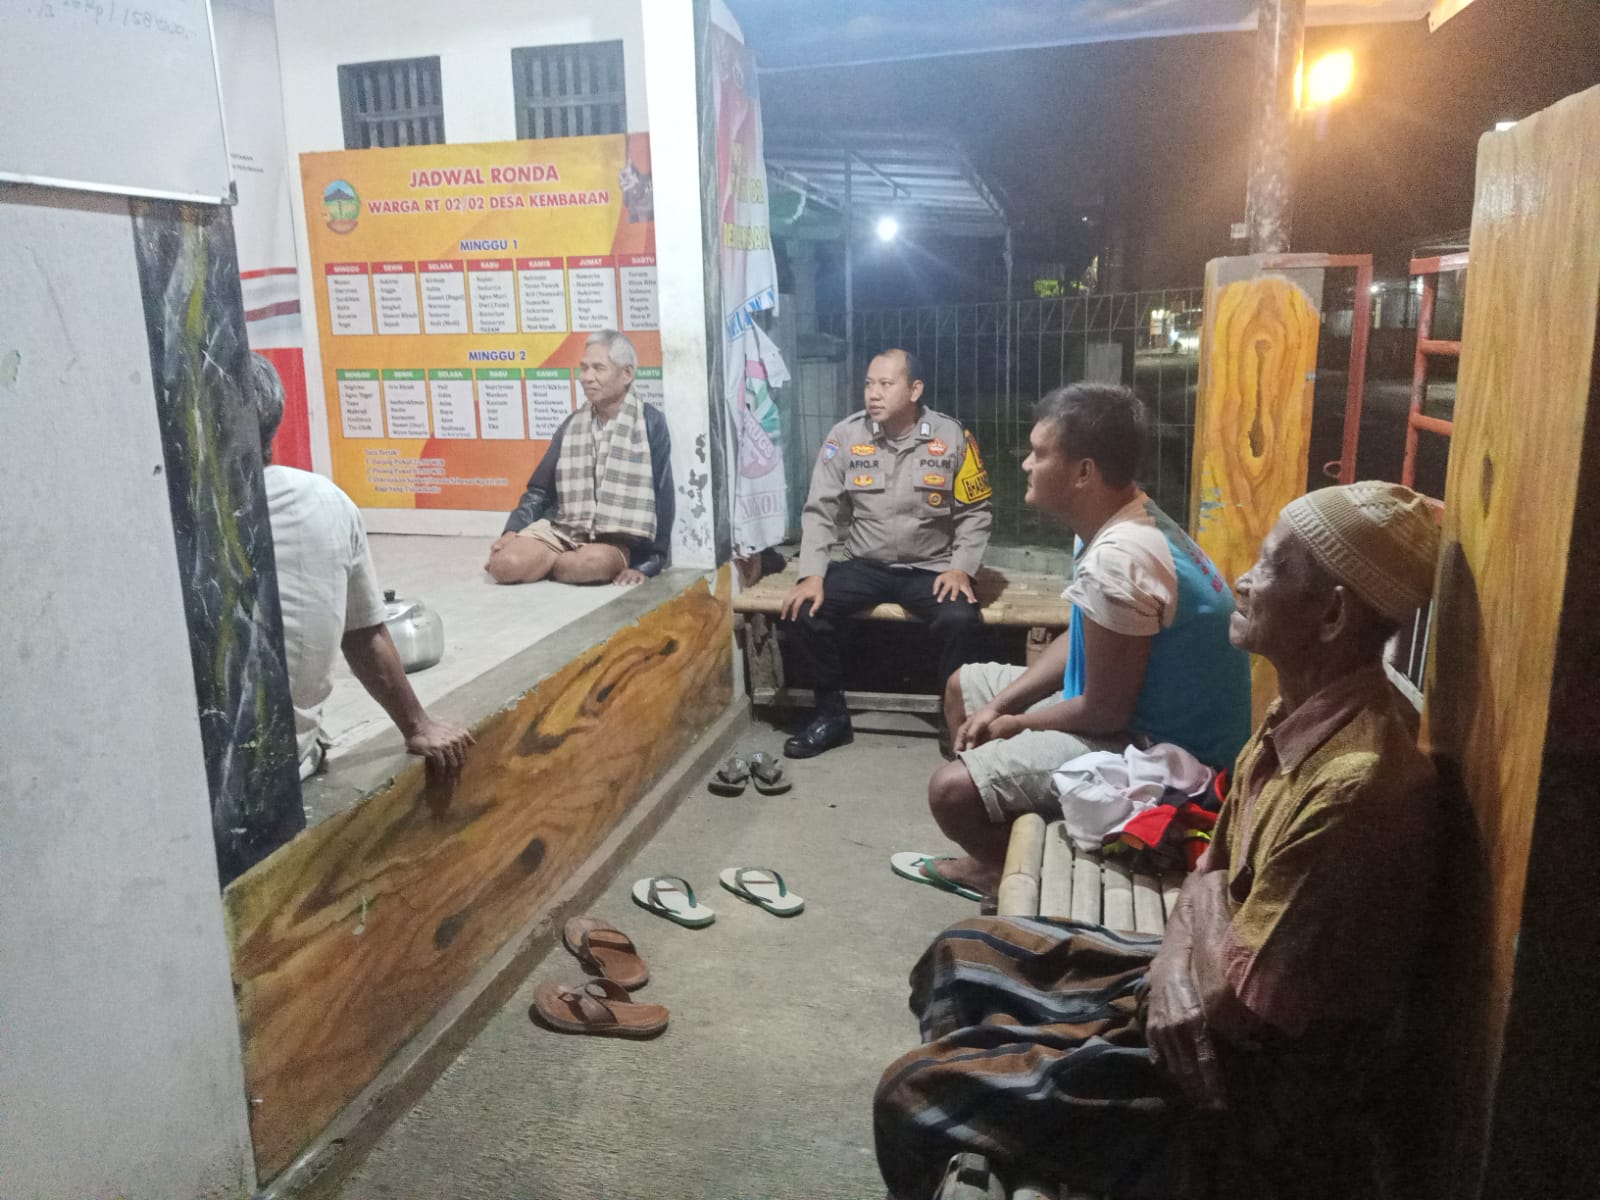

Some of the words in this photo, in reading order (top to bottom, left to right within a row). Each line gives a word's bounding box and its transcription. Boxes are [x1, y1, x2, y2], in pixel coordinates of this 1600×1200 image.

[409, 168, 485, 188] JADWAL
[491, 164, 559, 184] RONDA
[368, 200, 420, 215] WARGA
[425, 200, 440, 212] RT
[445, 196, 485, 211] 02/02
[490, 194, 525, 209] DESA
[530, 191, 609, 209] KEMBARAN
[459, 240, 508, 251] MINGGU
[513, 240, 518, 249] 1
[427, 262, 454, 270] SELASA
[579, 258, 602, 266] JUMAT
[468, 351, 516, 361] MINGGU
[519, 350, 526, 360] 2
[919, 458, 951, 469] POLRI
